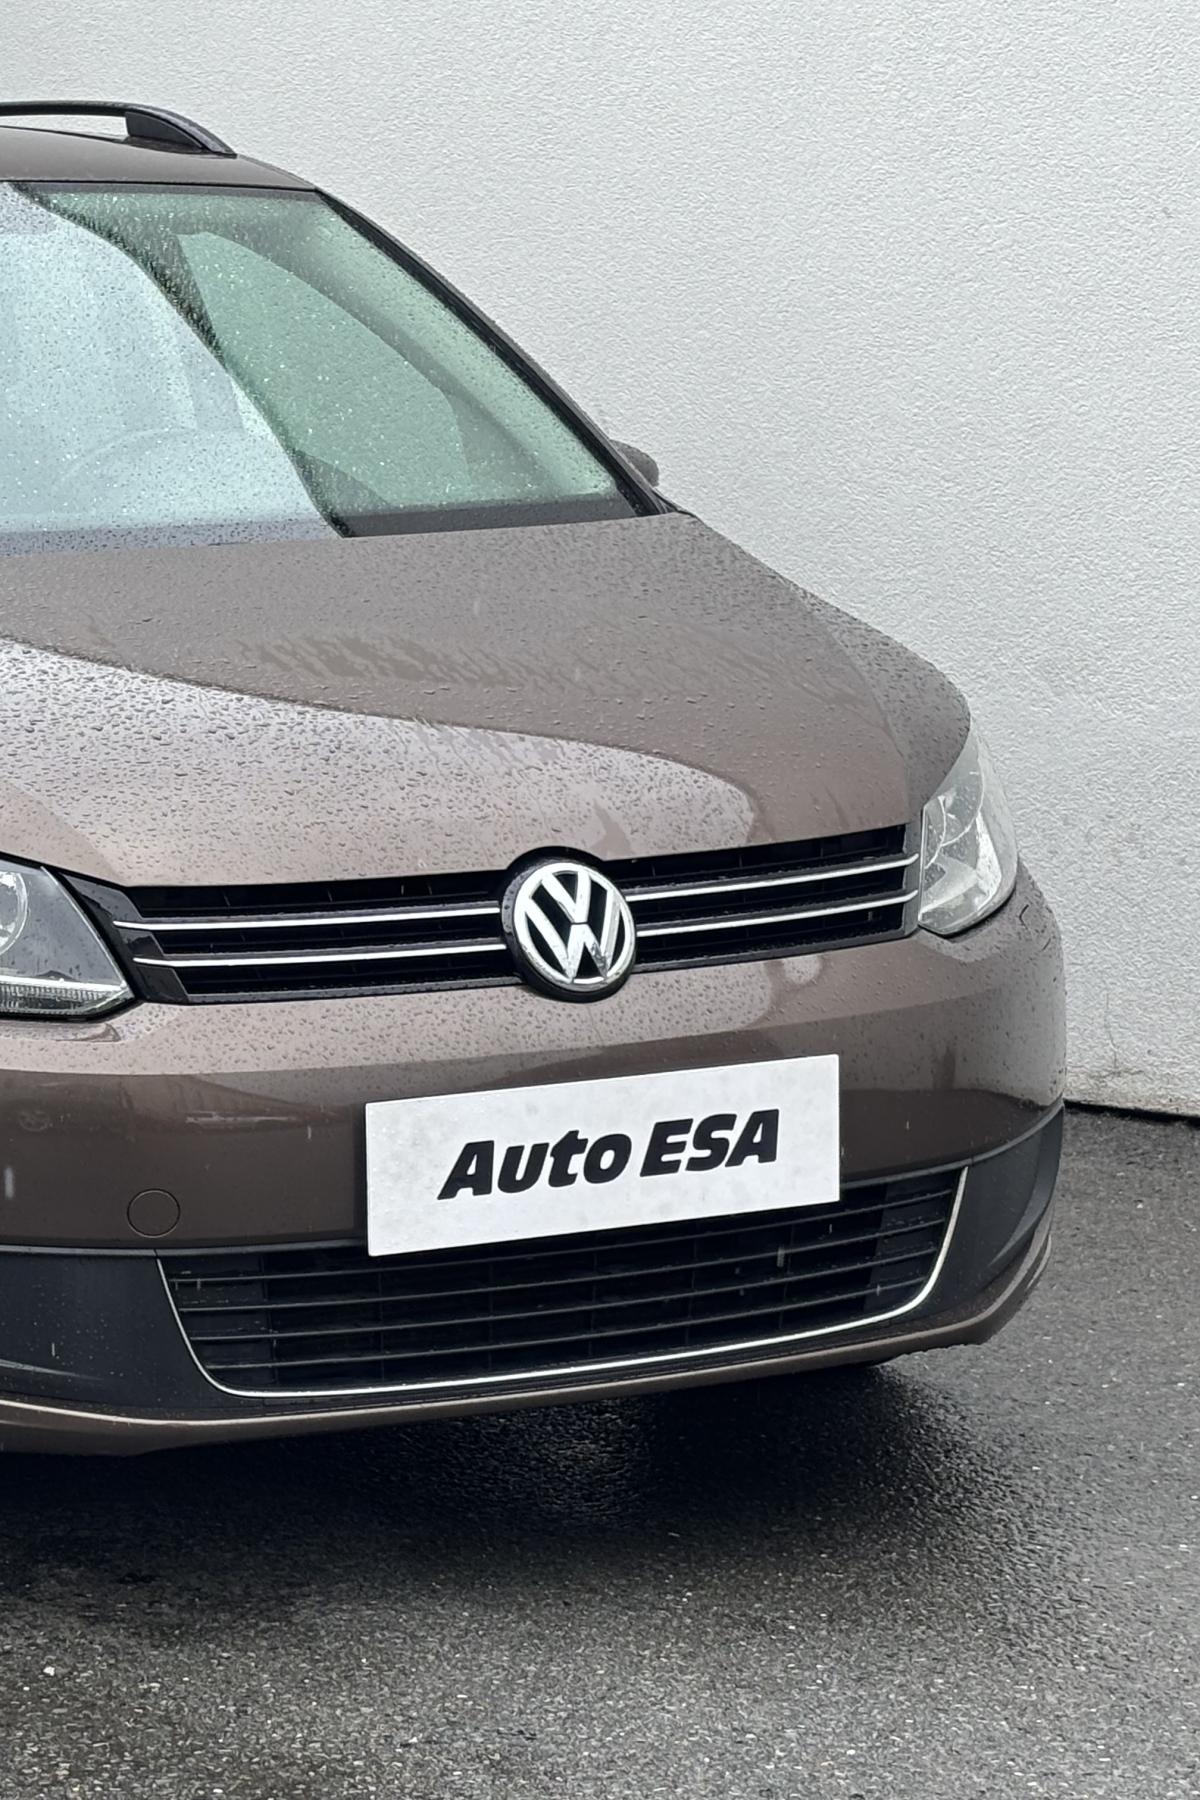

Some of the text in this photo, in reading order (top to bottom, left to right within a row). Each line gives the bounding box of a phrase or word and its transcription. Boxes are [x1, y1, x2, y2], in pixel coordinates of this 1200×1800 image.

[516, 865, 632, 988] VW
[437, 1109, 780, 1200] Auto ESA
